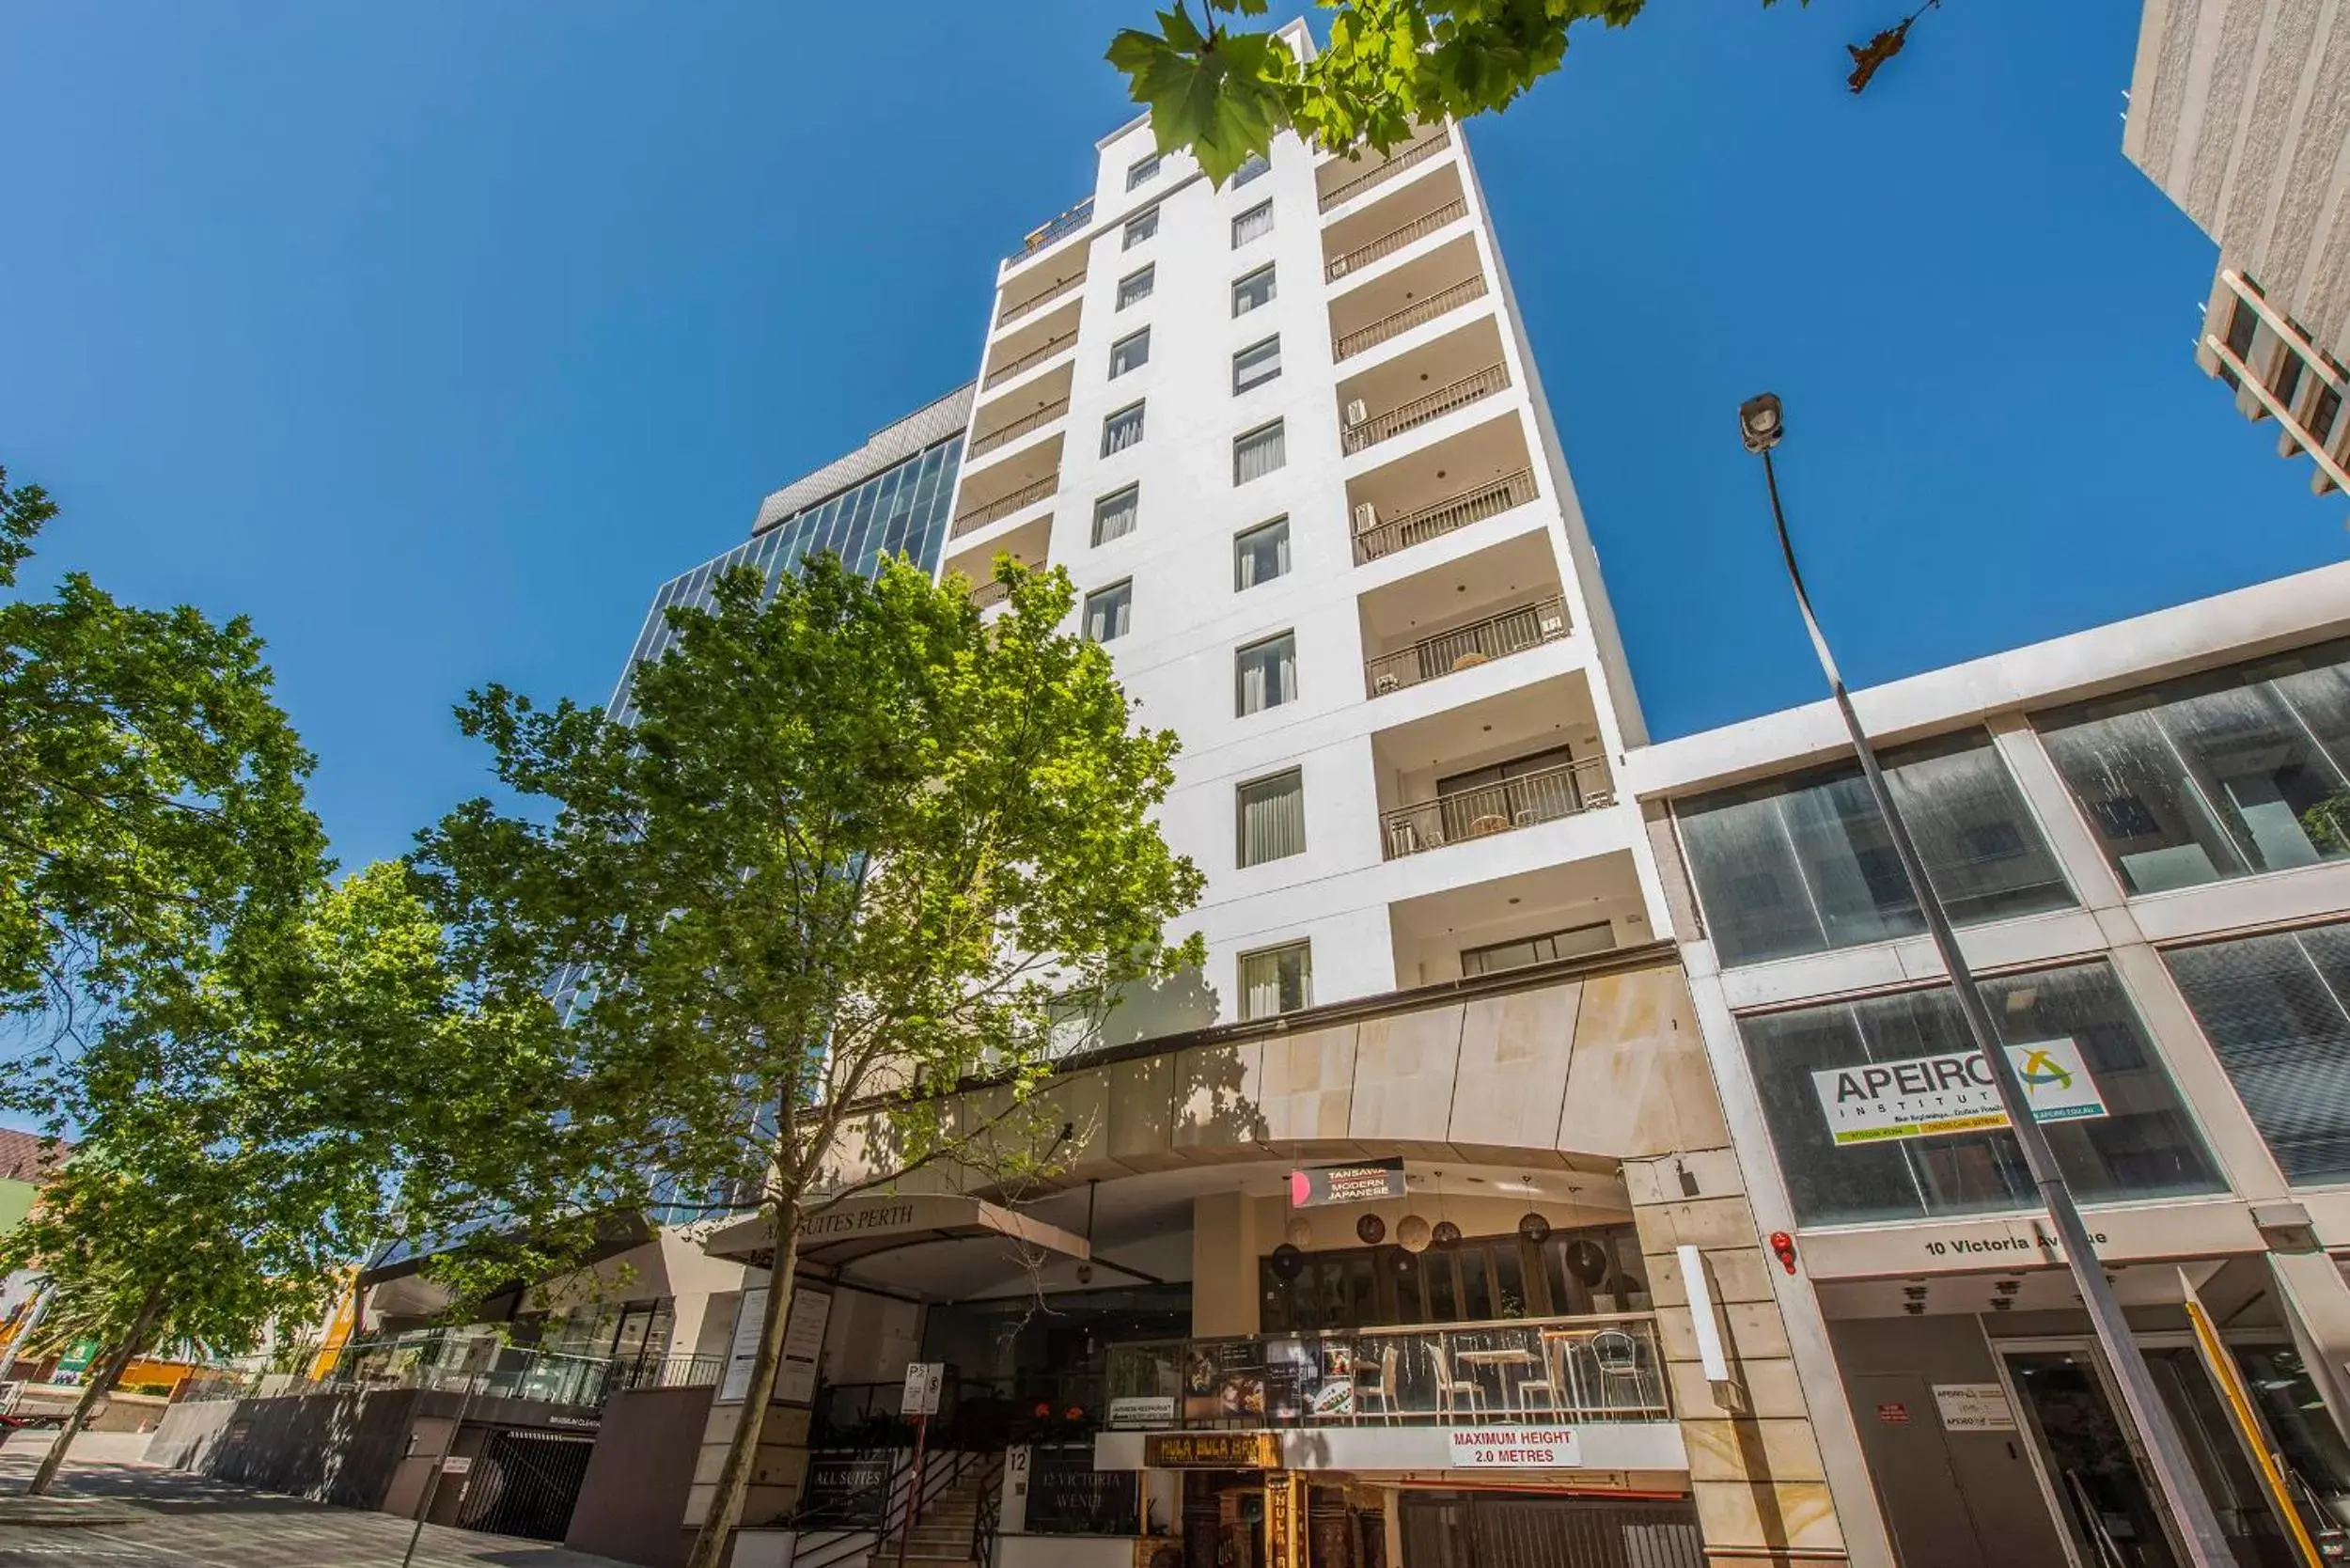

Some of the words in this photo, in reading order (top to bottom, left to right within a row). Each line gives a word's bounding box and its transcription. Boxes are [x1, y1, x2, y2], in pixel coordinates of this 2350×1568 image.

[1840, 1090, 1989, 1119] INSTITUT
[1327, 1168, 1387, 1179] TANSAWA
[1328, 1185, 1389, 1200] JAPANESE
[1331, 1179, 1385, 1192] MODERN
[799, 1213, 854, 1236] SUITES
[857, 1204, 914, 1229] PERTH
[1926, 1242, 1946, 1256] 10
[1951, 1235, 2029, 1254] Victoria
[2037, 1233, 2107, 1247] Avue
[1454, 1432, 1516, 1446] MAXIMUM
[1521, 1431, 1571, 1444] HEIGHT
[1162, 1439, 1192, 1456] HULA
[1196, 1438, 1228, 1456] BULA
[1011, 1453, 1026, 1471] 12
[1475, 1450, 1494, 1463] 2.0
[1498, 1450, 1554, 1463] METRES
[838, 1470, 881, 1485] SUITES
